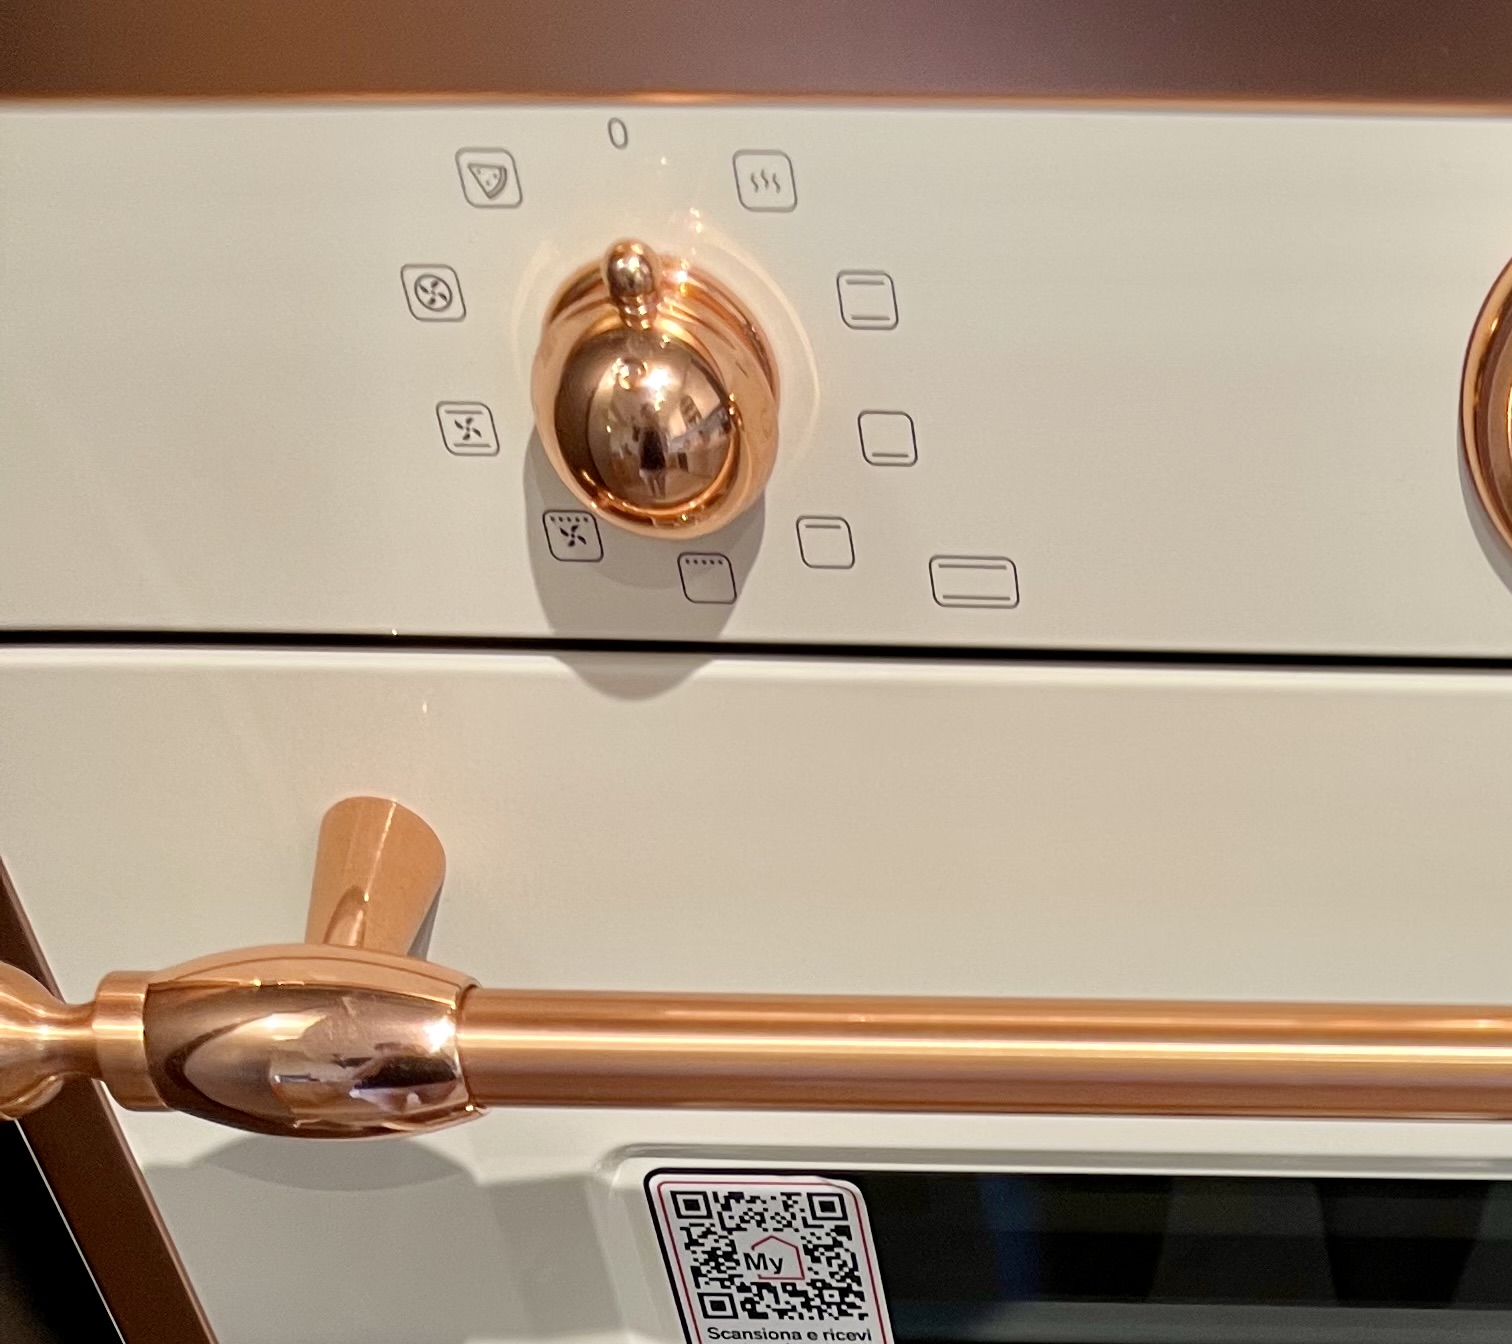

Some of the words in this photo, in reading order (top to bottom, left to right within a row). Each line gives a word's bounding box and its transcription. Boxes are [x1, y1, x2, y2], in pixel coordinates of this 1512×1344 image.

[607, 117, 628, 149] 0
[743, 1252, 784, 1274] My
[707, 1327, 801, 1341] Scansiona
[807, 1330, 818, 1341] e
[823, 1328, 872, 1341] ricevi
